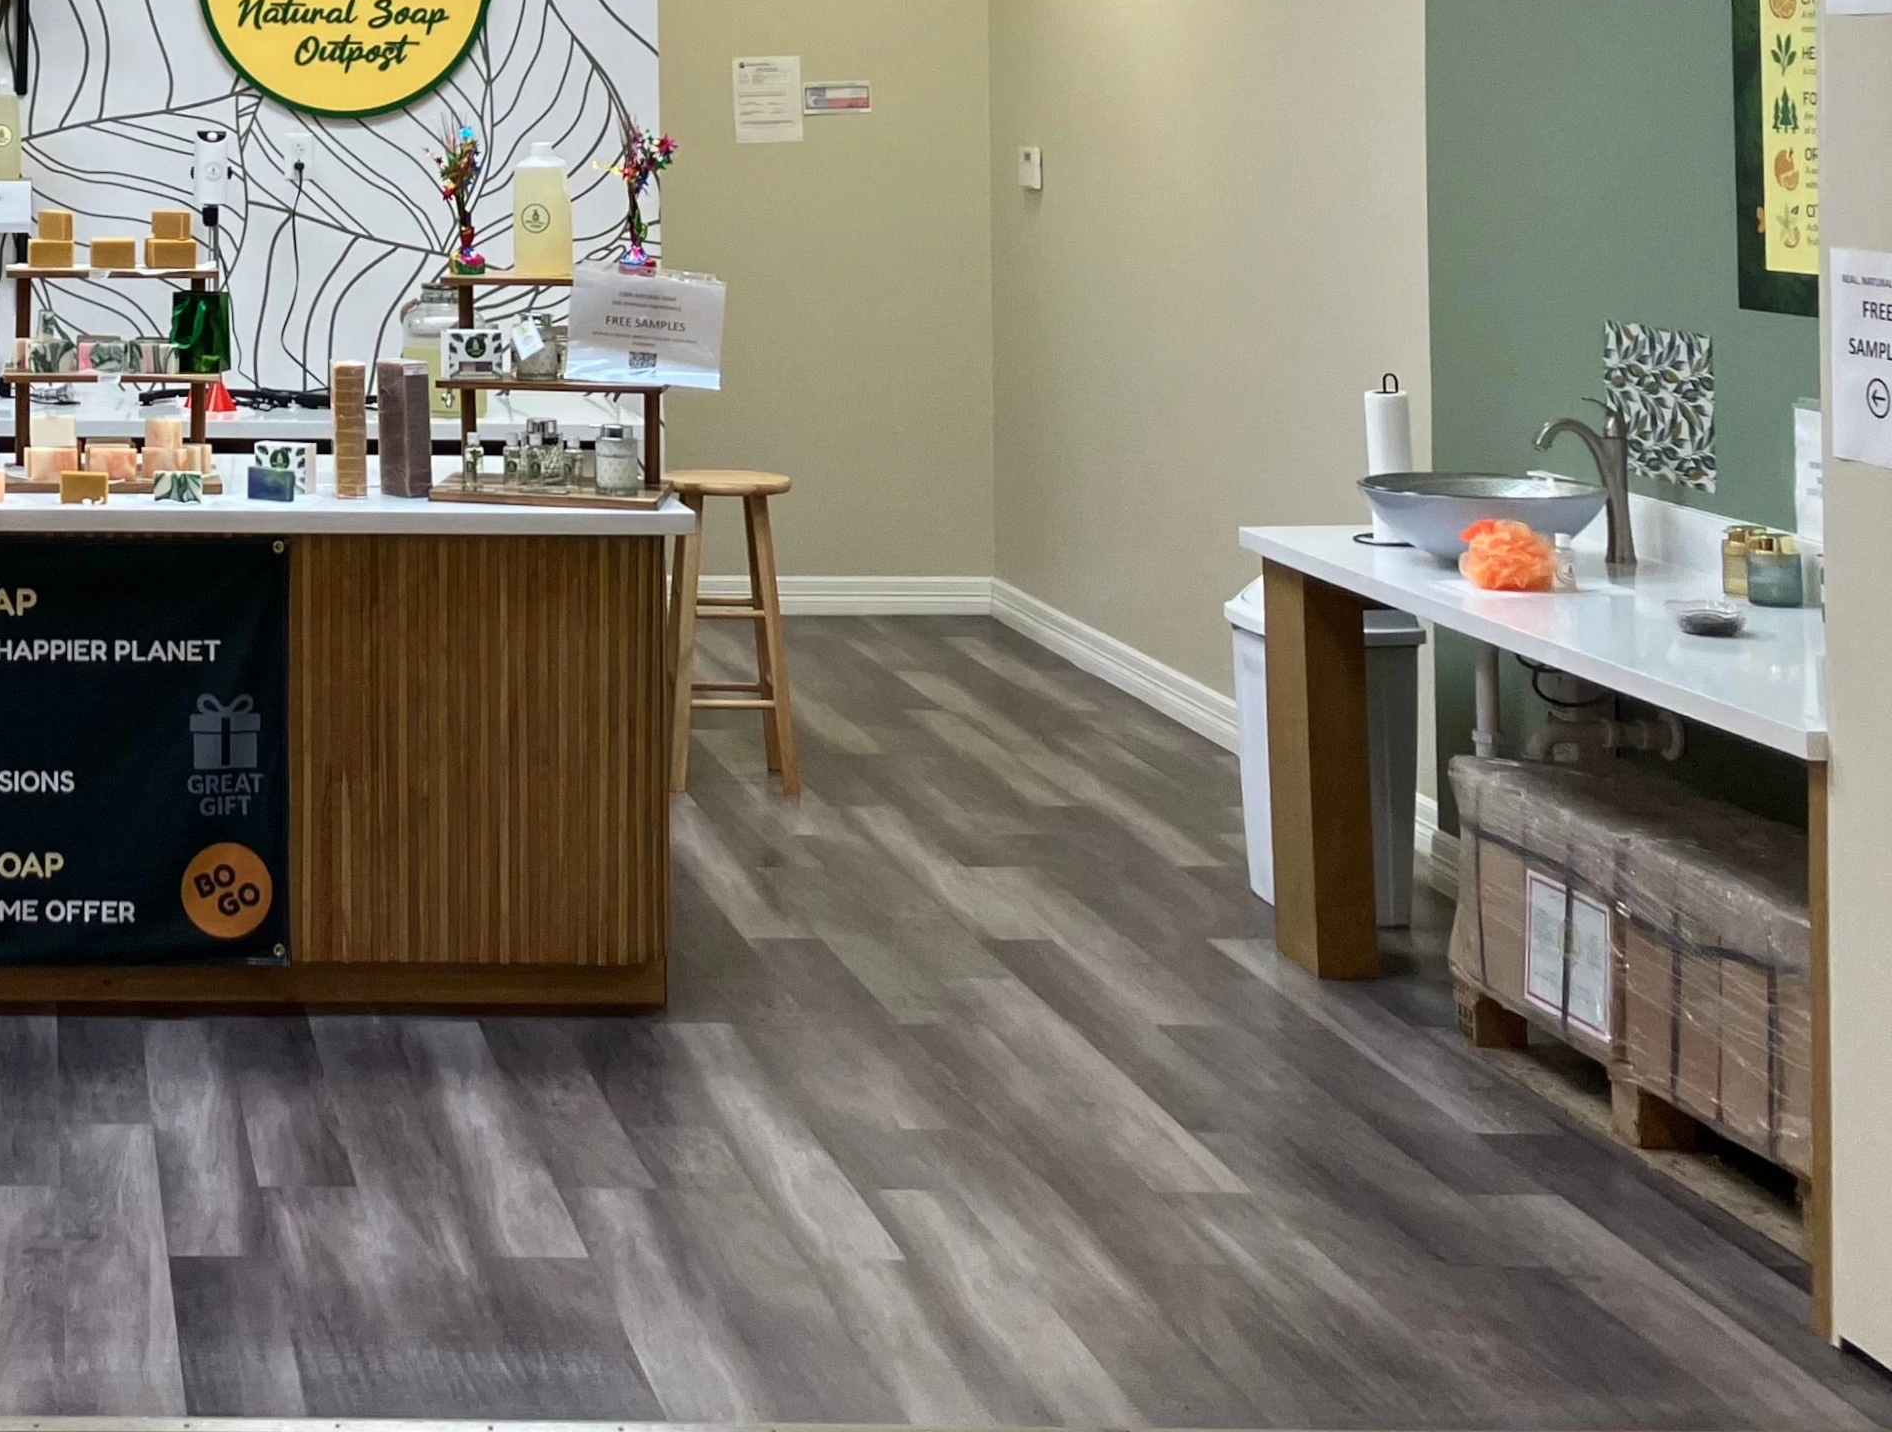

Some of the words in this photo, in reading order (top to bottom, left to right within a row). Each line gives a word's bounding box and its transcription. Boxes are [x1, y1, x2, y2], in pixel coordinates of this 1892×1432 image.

[294, 34, 420, 73] Outpost
[1862, 300, 1892, 321] FREE
[605, 314, 633, 329] FREE
[635, 317, 687, 333] SAMPLES
[114, 639, 222, 662] PLANET
[186, 772, 265, 795] GREAT
[199, 794, 252, 817] GIFT
[45, 899, 135, 923] OFFER
